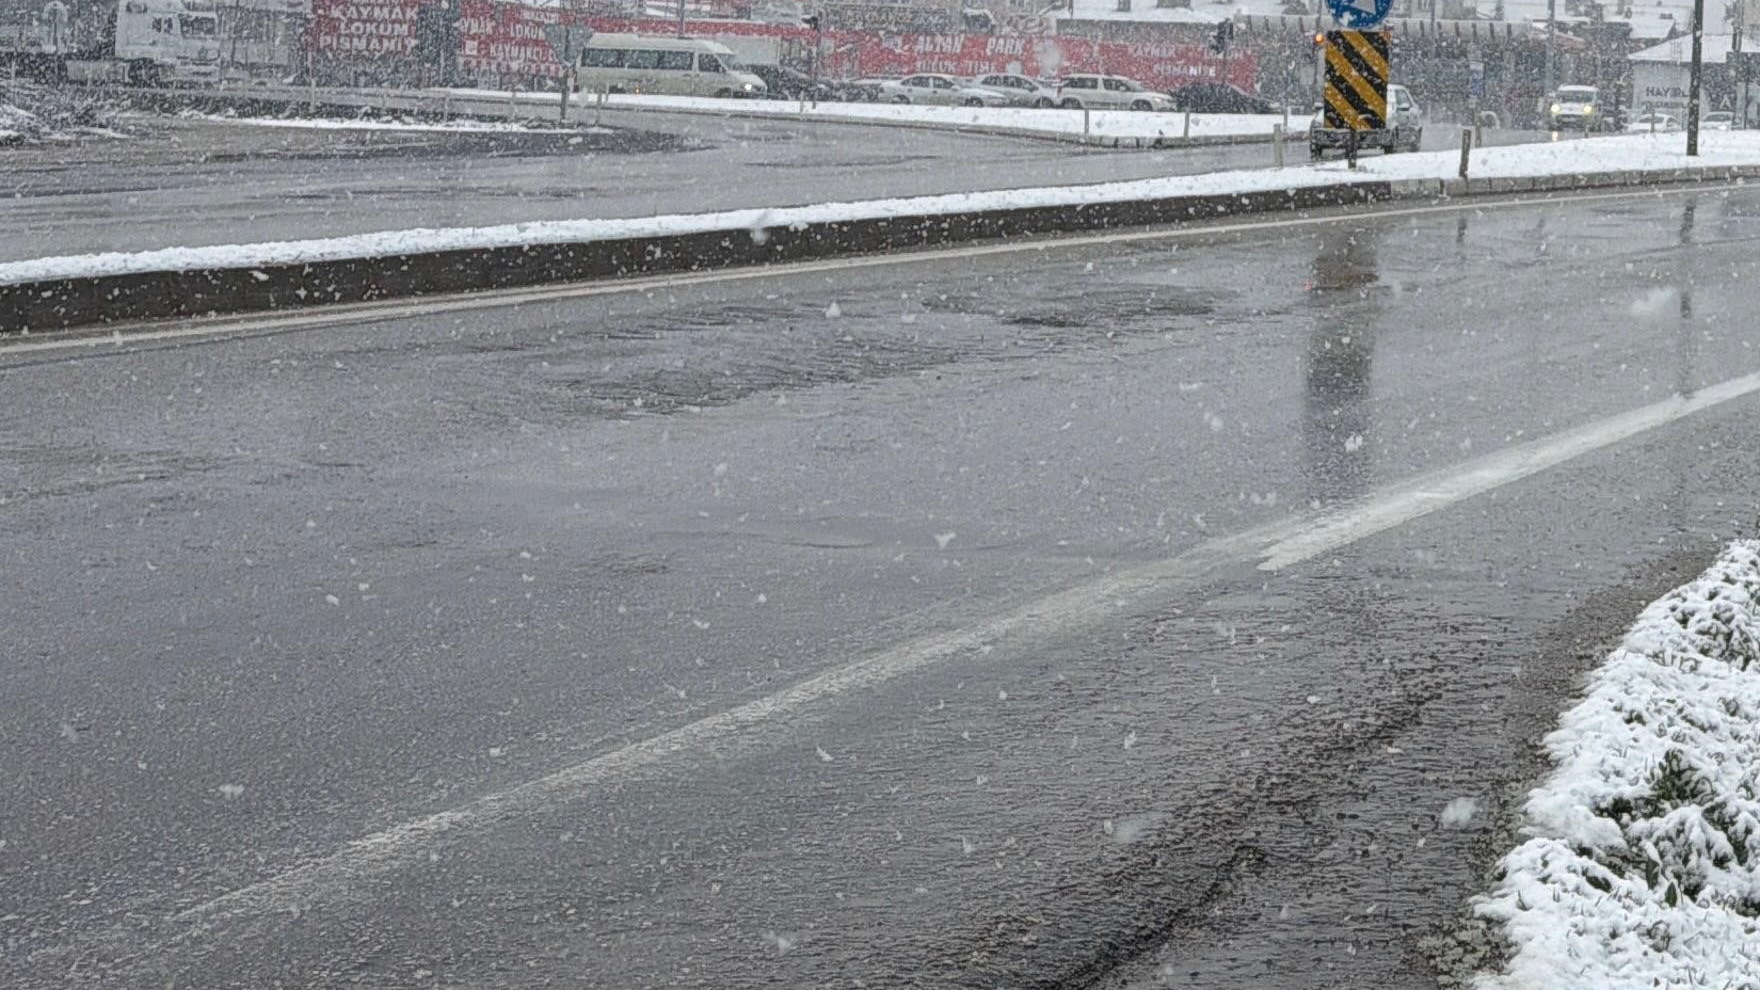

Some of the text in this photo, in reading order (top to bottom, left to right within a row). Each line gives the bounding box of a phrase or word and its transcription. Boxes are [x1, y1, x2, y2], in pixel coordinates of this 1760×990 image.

[331, 4, 418, 20] KAYMAK
[339, 20, 409, 36] LOKUM
[986, 36, 1025, 55] PARK
